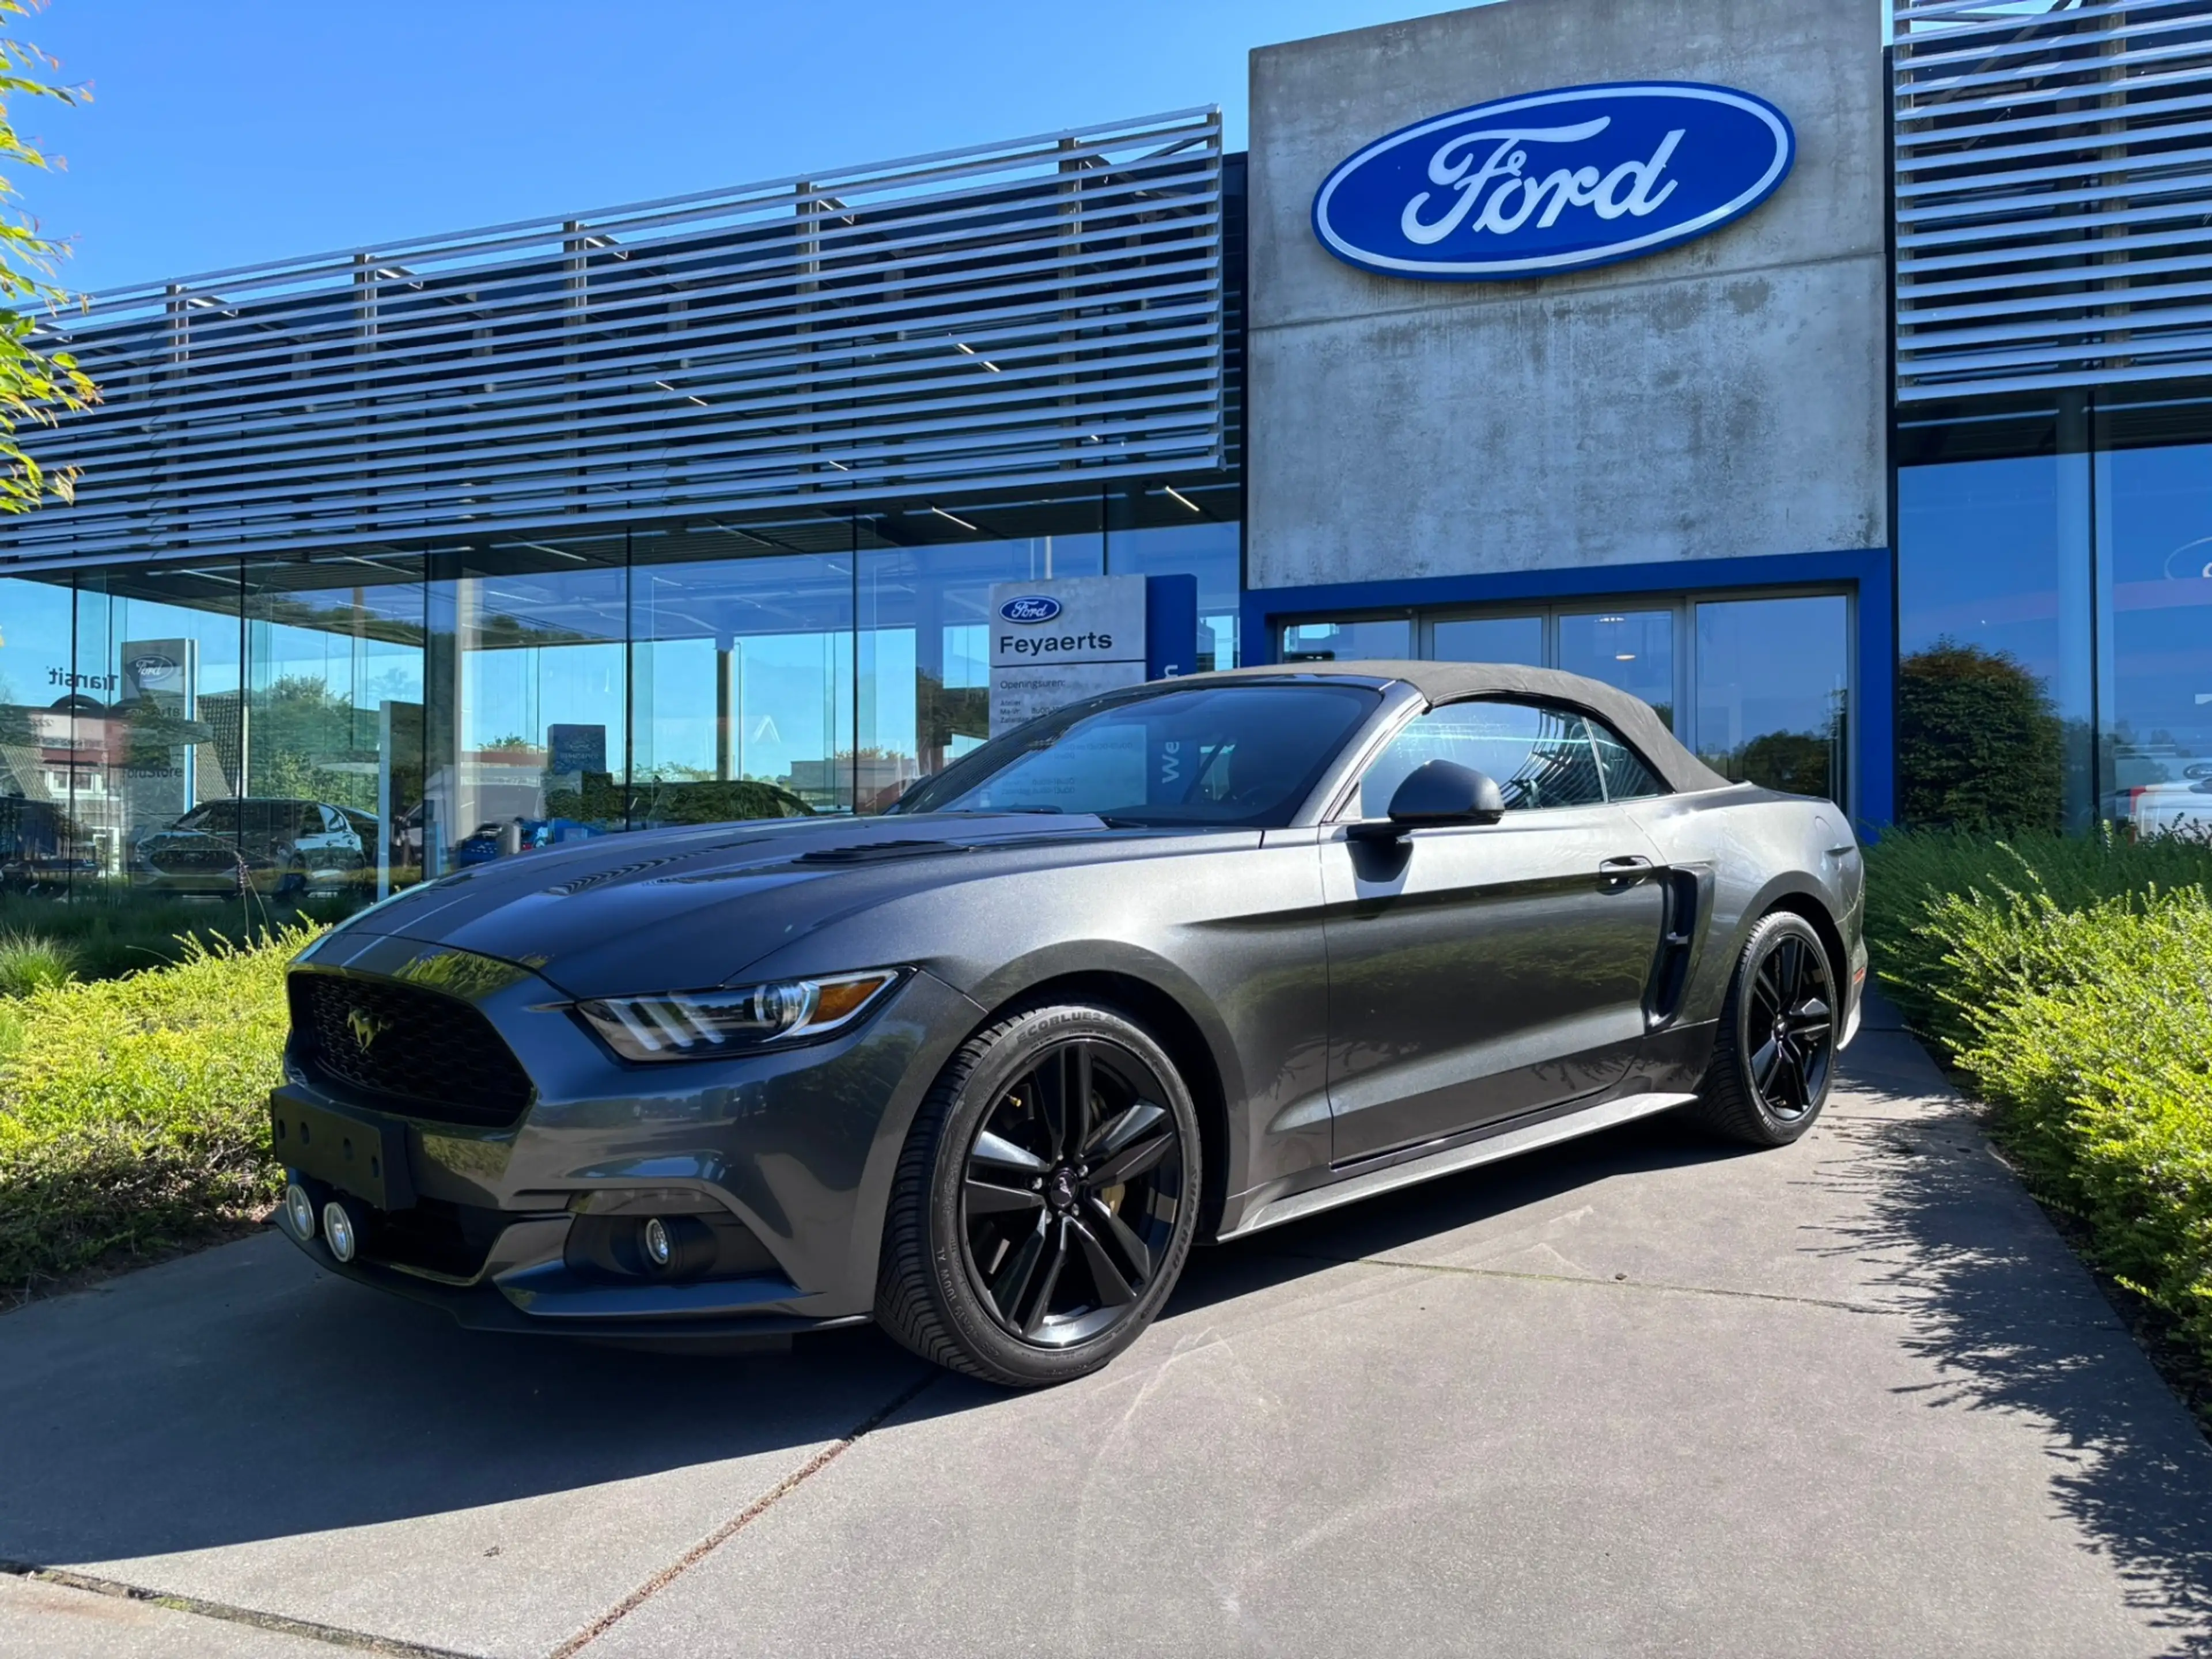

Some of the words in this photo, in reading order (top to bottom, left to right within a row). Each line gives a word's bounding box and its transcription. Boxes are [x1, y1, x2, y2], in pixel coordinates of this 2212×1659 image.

[1401, 115, 1686, 244] Ford
[1010, 600, 1048, 618] Ford
[999, 631, 1113, 657] Feyaerts
[135, 658, 163, 676] Ford
[1161, 741, 1180, 784] We
